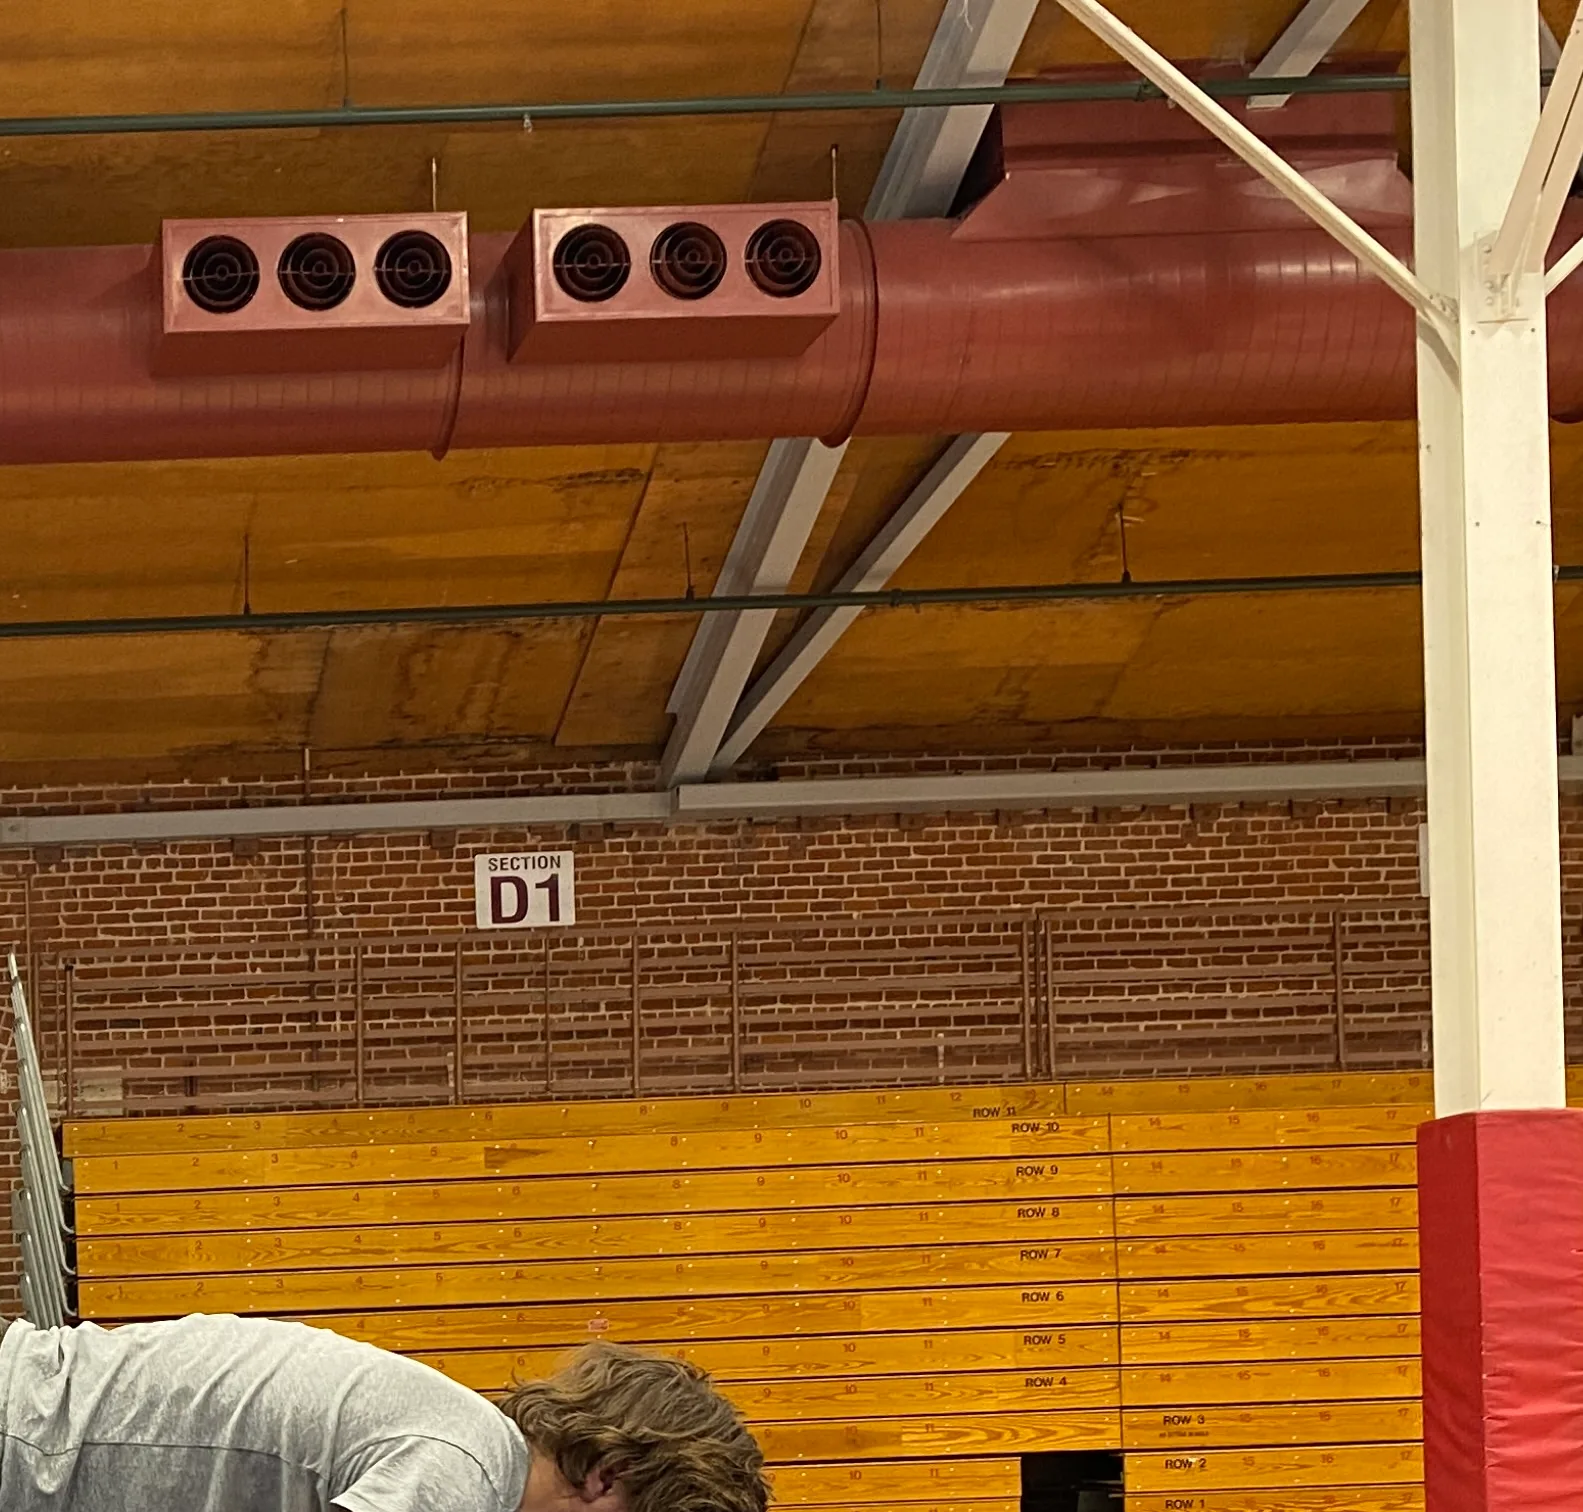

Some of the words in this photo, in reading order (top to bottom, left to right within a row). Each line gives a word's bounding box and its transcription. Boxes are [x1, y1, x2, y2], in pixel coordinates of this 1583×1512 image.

[488, 855, 561, 871] SECTION
[490, 872, 560, 925] D1
[950, 1091, 962, 1102] 12
[799, 1098, 812, 1109] 10
[973, 1108, 1000, 1118] ROW
[1006, 1107, 1016, 1116] 11
[1385, 1109, 1398, 1120] 17
[915, 1127, 925, 1137] 11
[1012, 1123, 1039, 1133] ROW
[1046, 1122, 1059, 1132] 10
[835, 1129, 848, 1140] 10
[918, 1170, 928, 1181] 11
[1016, 1166, 1045, 1176] ROW
[1051, 1165, 1058, 1175] 9
[837, 1173, 850, 1183] 10
[1389, 1197, 1402, 1207] 17
[919, 1211, 929, 1222] 11
[1018, 1208, 1045, 1218] ROW
[1052, 1207, 1060, 1217] 8
[839, 1214, 852, 1225] 10
[921, 1254, 931, 1264] 11
[1020, 1250, 1048, 1261] ROW
[1054, 1249, 1062, 1259] 7
[841, 1256, 854, 1267] 10
[1395, 1281, 1408, 1292] 17
[922, 1296, 932, 1307] 11
[1022, 1292, 1050, 1302] ROW
[1056, 1291, 1064, 1301] 6
[843, 1300, 856, 1311] 10
[1396, 1323, 1409, 1334] 17
[924, 1339, 934, 1349] 11
[1024, 1335, 1051, 1345] ROW
[1058, 1334, 1066, 1344] 5
[843, 1342, 856, 1353] 10
[924, 1381, 934, 1392] 11
[1025, 1378, 1054, 1388] ROW
[1059, 1377, 1067, 1386] 4
[845, 1384, 858, 1395] 10
[1163, 1415, 1191, 1425] ROW
[1198, 1415, 1205, 1424] 3
[1165, 1459, 1193, 1469] ROW
[1199, 1458, 1206, 1468] 2
[849, 1470, 862, 1481] 10
[929, 1467, 939, 1478] 11
[1166, 1500, 1193, 1510] ROW
[1200, 1499, 1205, 1509] 1
